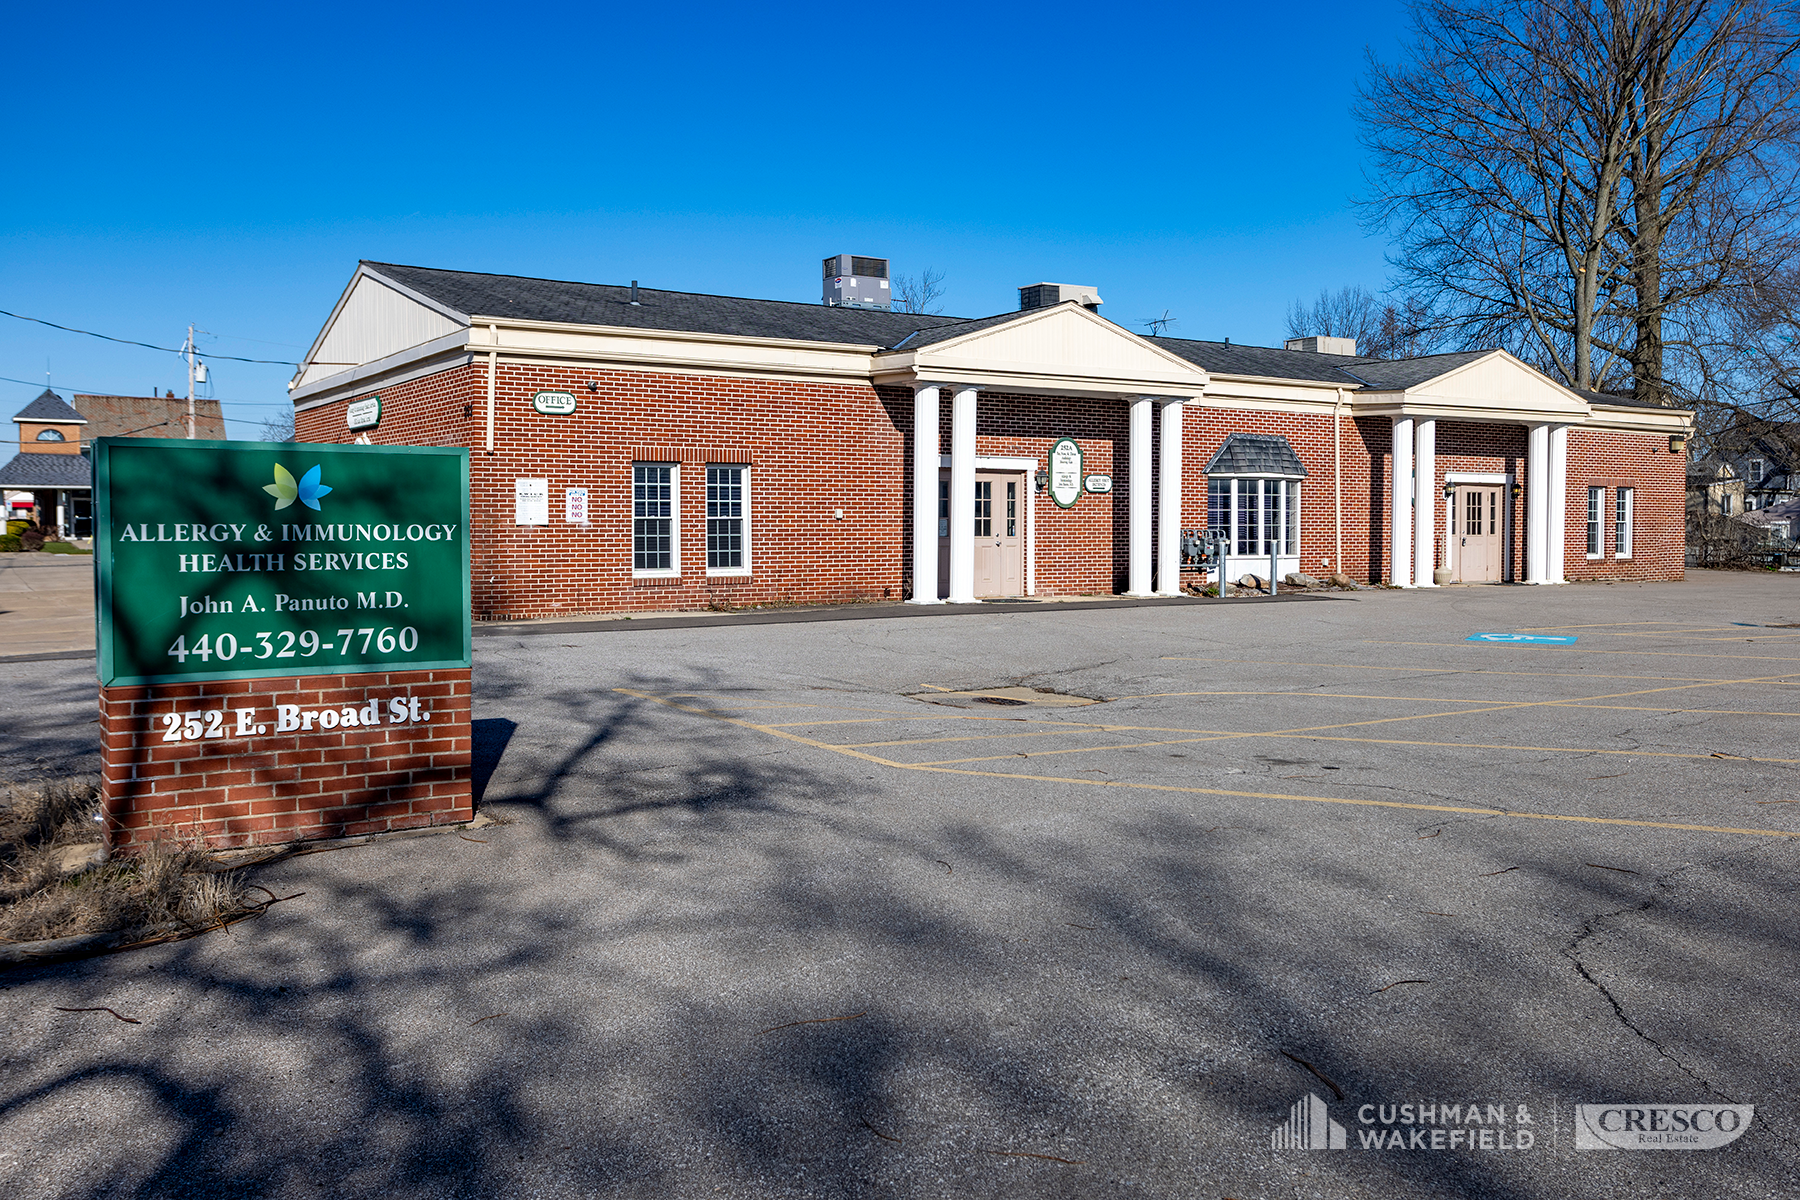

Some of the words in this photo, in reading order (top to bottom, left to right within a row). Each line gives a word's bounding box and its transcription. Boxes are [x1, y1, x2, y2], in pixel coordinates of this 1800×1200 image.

[538, 395, 572, 405] OFFICE
[119, 523, 247, 542] ALLERGY
[253, 523, 273, 541] &
[281, 523, 457, 541] IMMUNOLOGY
[178, 553, 284, 573] HEALTH
[293, 552, 409, 571] SERVICES
[179, 594, 233, 618] John
[241, 594, 266, 613] A.
[274, 593, 349, 612] Panuto
[356, 591, 409, 609] M.D.
[168, 626, 419, 663] 440-329-7760
[162, 709, 224, 742] 252
[235, 706, 267, 737] E.
[276, 698, 380, 733] Broad
[389, 695, 431, 724] St.
